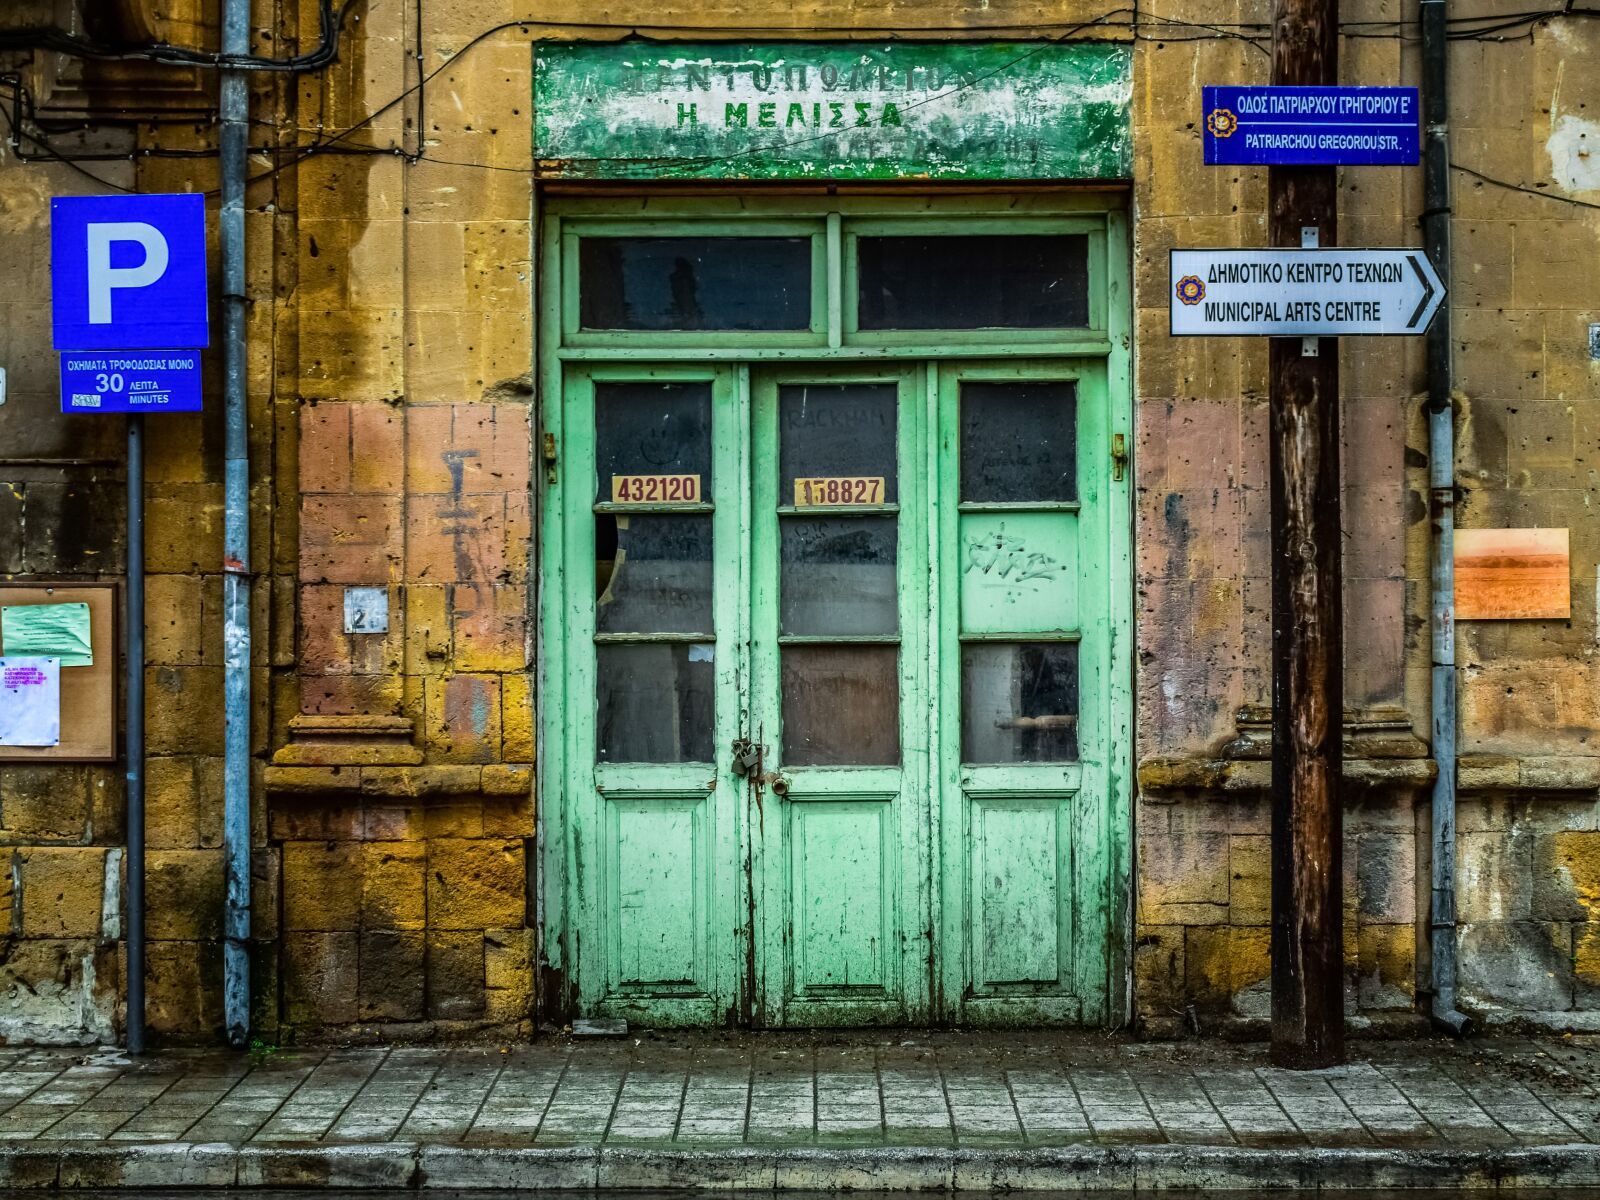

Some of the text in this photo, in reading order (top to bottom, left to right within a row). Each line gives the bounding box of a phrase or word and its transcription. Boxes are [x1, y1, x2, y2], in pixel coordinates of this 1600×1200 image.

[677, 102, 902, 128] Η ΜΕΛΙΣΣΑ
[1237, 96, 1267, 114] ΟΔΟΣ
[1270, 96, 1337, 114] ΠΑΤΡΙΑΡΧΟΥ
[1340, 96, 1399, 114] ΓΡΗΓΟΡΙΟΥ
[1246, 134, 1316, 149] PATRIARCHOU
[1318, 135, 1377, 150] GREGORIOU
[87, 222, 169, 324] P
[1208, 262, 1403, 284] ΔΗΜΟΤΙΚΟ ΚΕΝΤΡΟ ΤΕΧΝΩΝ
[1204, 301, 1381, 322] MUNICIPAL ARTS CENTRE
[67, 358, 194, 371] ΟΧΗΜΑΤΑ ΤΡΟΦΟΔΟΣΙΑΣ ΜΟΝΟ
[95, 373, 159, 393] 30 ΛΕΠΤΑ
[129, 394, 169, 405] MINUTES
[617, 477, 696, 502] 432120
